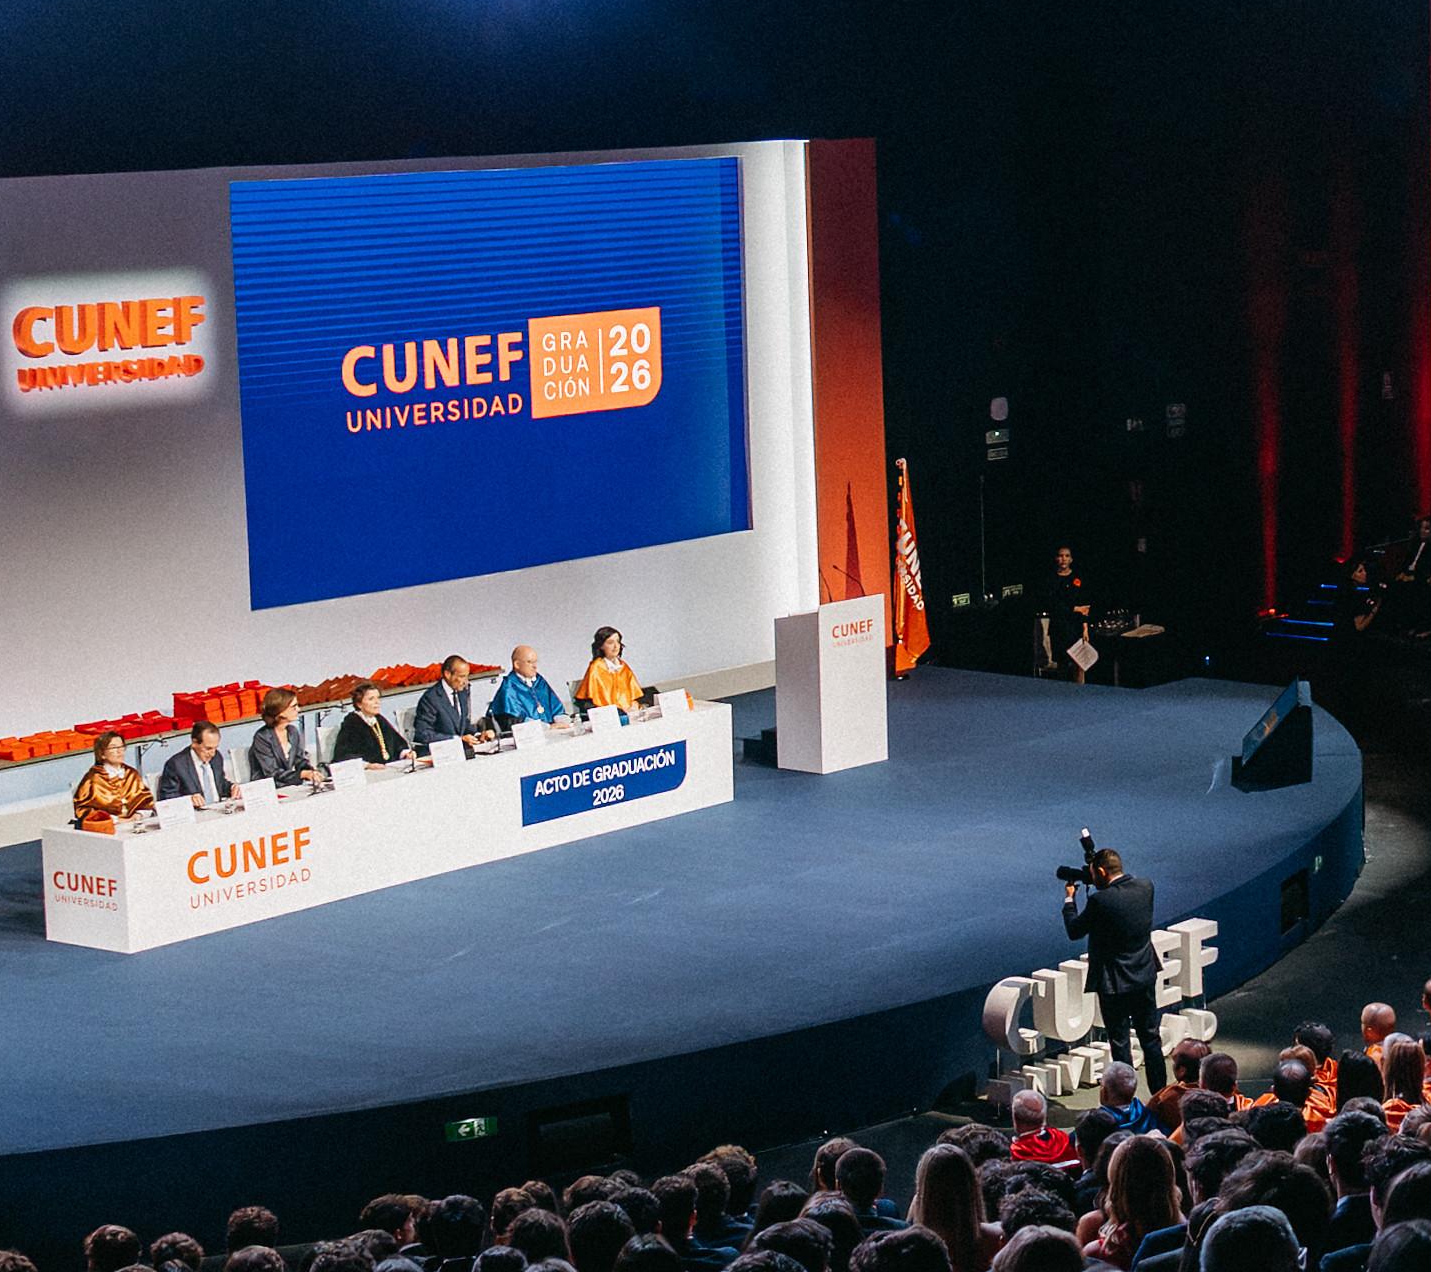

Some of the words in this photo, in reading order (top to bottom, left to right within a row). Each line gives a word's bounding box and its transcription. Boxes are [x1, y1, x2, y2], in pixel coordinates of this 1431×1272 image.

[12, 295, 206, 358] CUNEF
[541, 329, 589, 353] GRA
[608, 322, 652, 357] 20
[16, 354, 205, 393] UNIVERSIDAD
[341, 332, 524, 397] CUNEF
[543, 354, 590, 377] DUA
[609, 359, 652, 394] 26
[543, 376, 591, 401] CIÓN
[346, 393, 523, 434] UNIVERSIDAD
[832, 619, 873, 638] CUNEF
[534, 774, 571, 797] ACTO
[572, 769, 591, 788] DE
[592, 749, 676, 783] GRADUACIÓN
[592, 784, 625, 806] 2026
[187, 827, 312, 884] CUNEF
[53, 871, 118, 897] CUNEF
[190, 868, 312, 909] UNIVERSIDAD
[55, 894, 118, 912] UNIVERSIDAD
[982, 917, 1219, 1056] CUEF
